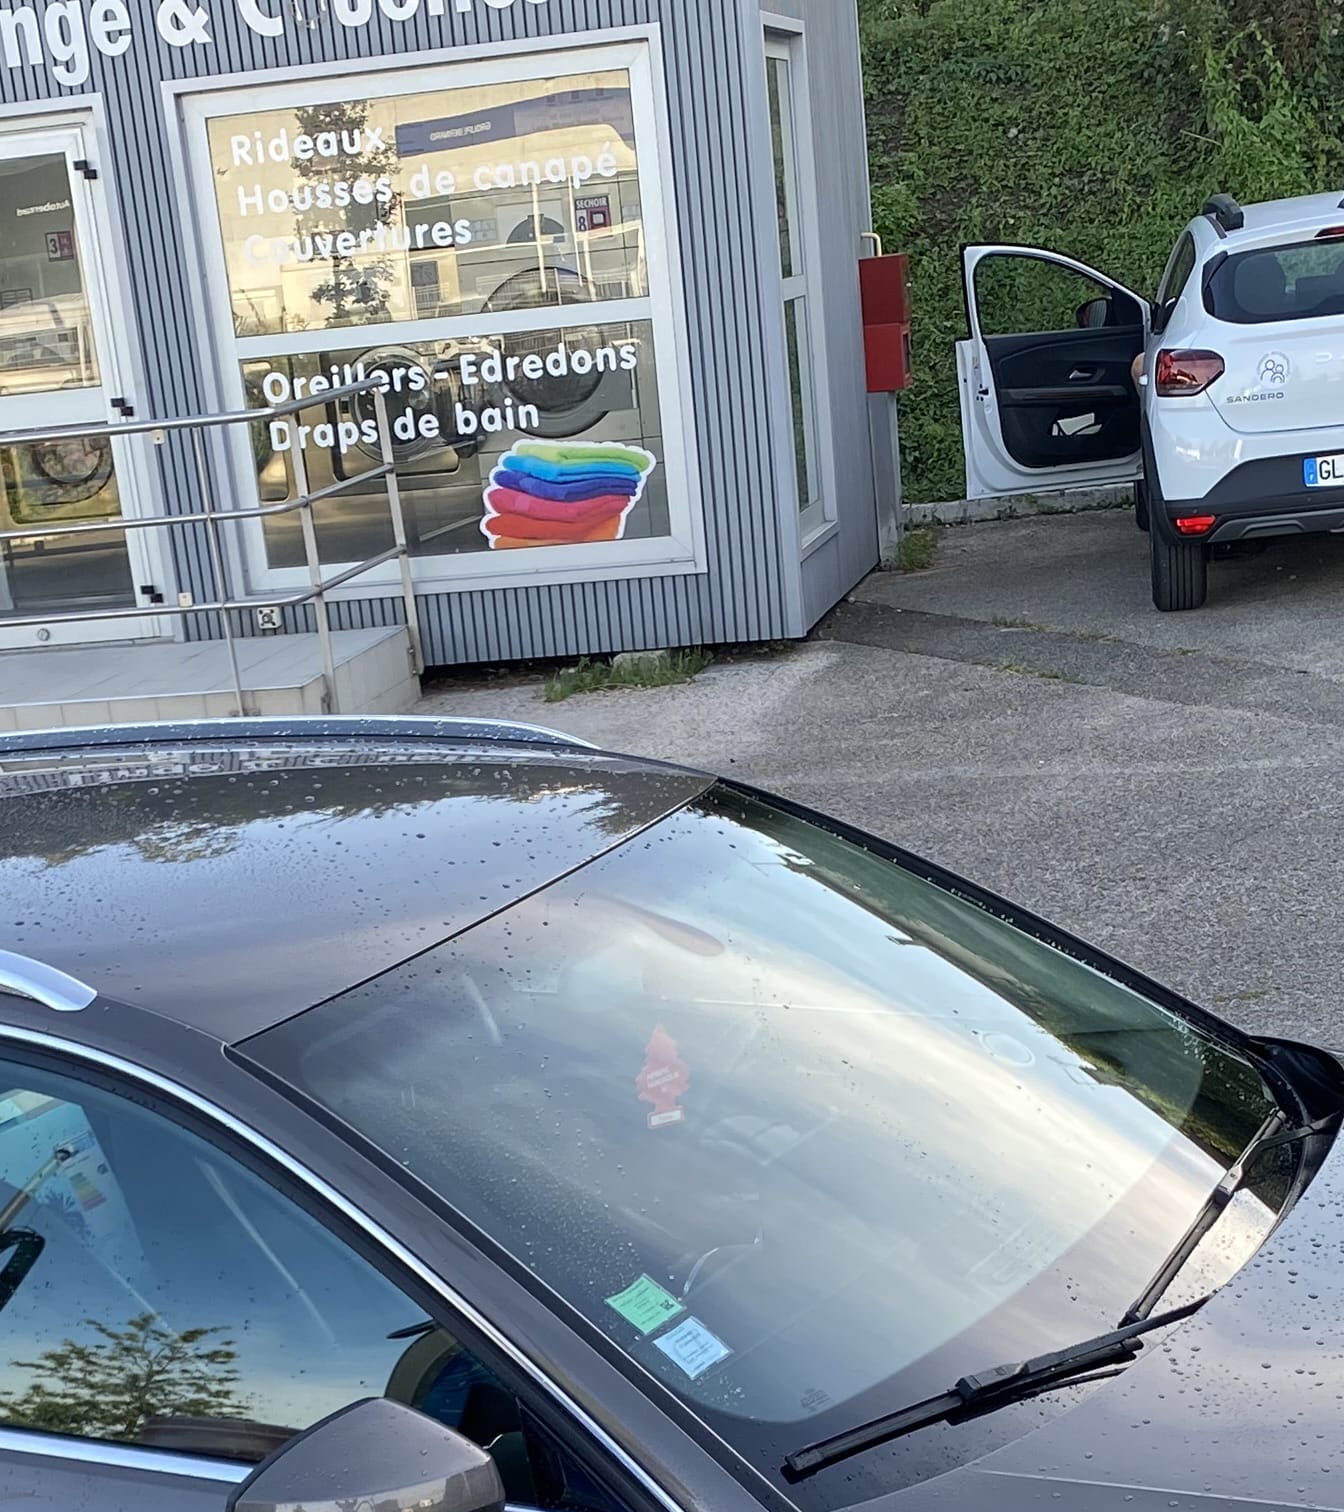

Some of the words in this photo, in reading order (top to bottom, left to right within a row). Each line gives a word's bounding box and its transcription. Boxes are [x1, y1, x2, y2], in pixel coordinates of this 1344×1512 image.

[230, 126, 387, 167] Rideaux
[236, 175, 394, 217] Housses
[409, 162, 456, 198] de
[472, 141, 618, 191] canapé
[242, 217, 473, 268] Couvertures
[578, 215, 587, 231] 8
[48, 238, 59, 254] 3
[458, 342, 638, 386] Edredons
[1226, 391, 1285, 404] SANDERO
[268, 418, 379, 455] Draps
[393, 406, 441, 441] de
[454, 396, 541, 436] bain
